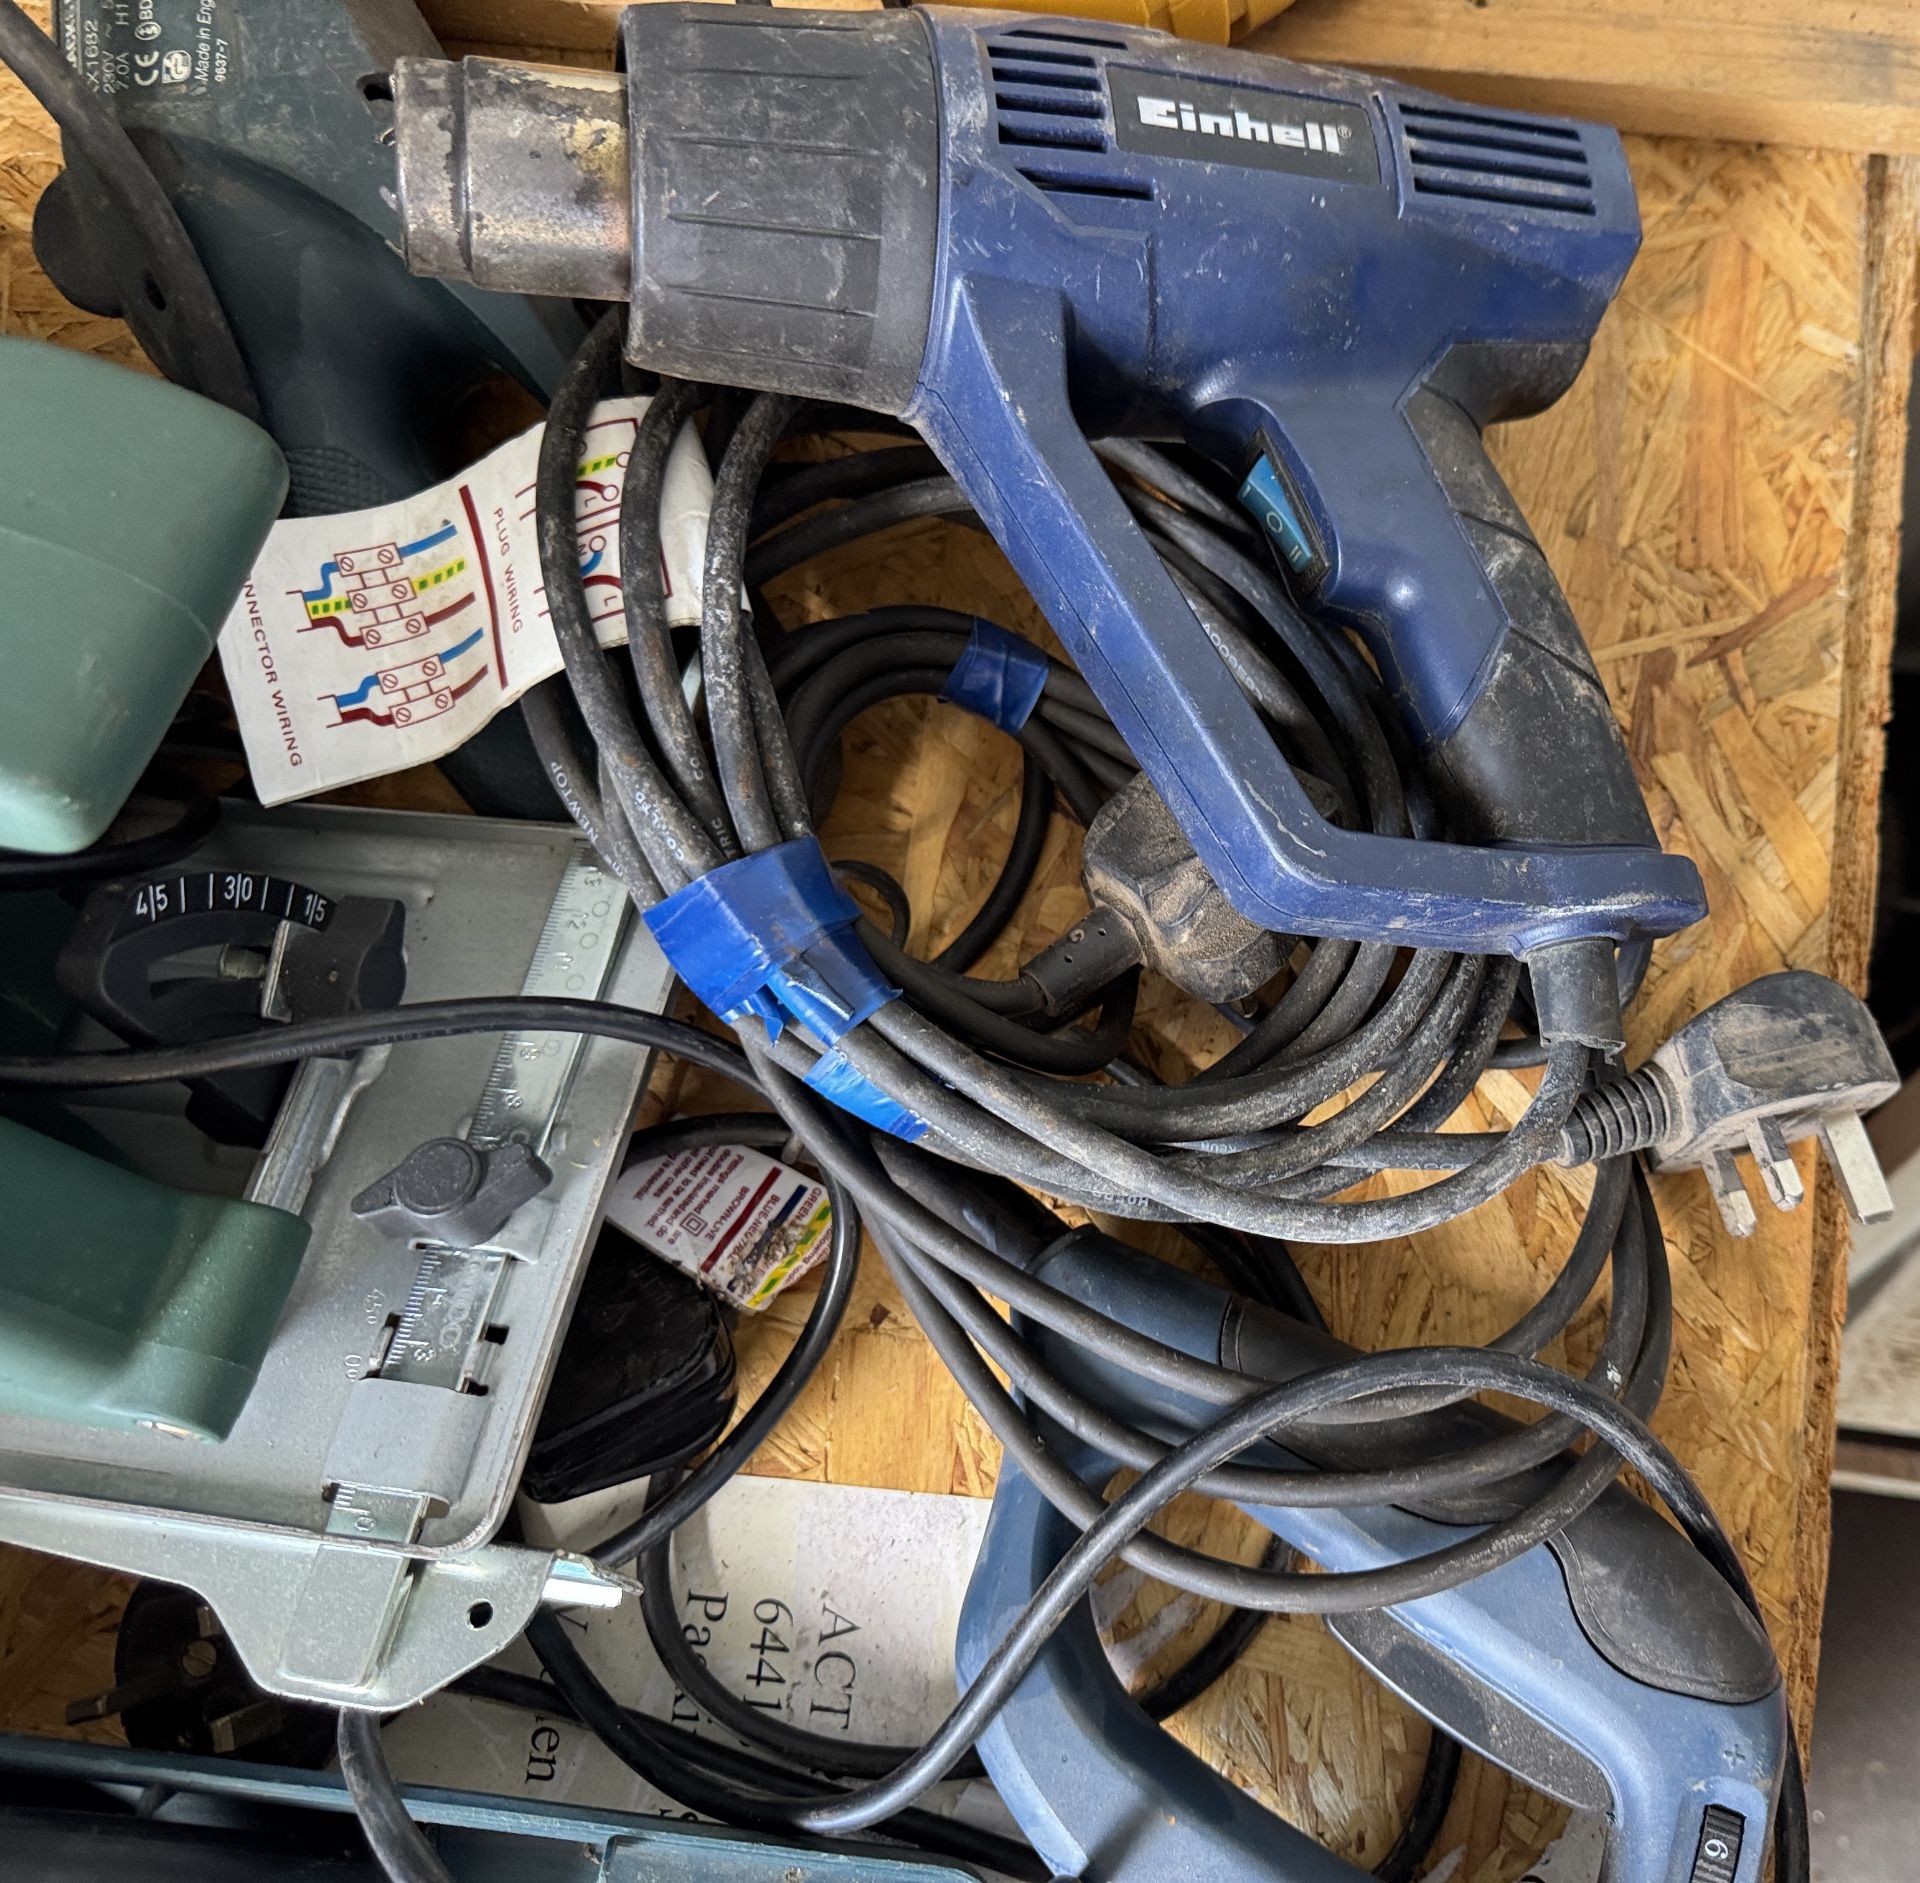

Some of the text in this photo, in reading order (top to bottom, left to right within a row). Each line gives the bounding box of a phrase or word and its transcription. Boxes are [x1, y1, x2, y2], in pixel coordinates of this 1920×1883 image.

[196, 0, 216, 25] Eng
[102, 50, 115, 94] 230V
[116, 52, 130, 91] 7.0A
[194, 43, 211, 82] Made
[584, 495, 598, 509] L
[493, 506, 524, 634] PLUG WIRING
[242, 578, 304, 768] NNECTOR WIRING
[551, 761, 599, 844] NEWTOP
[704, 1186, 750, 1241] BROWN-LIVE
[809, 1603, 861, 1730] ACT
